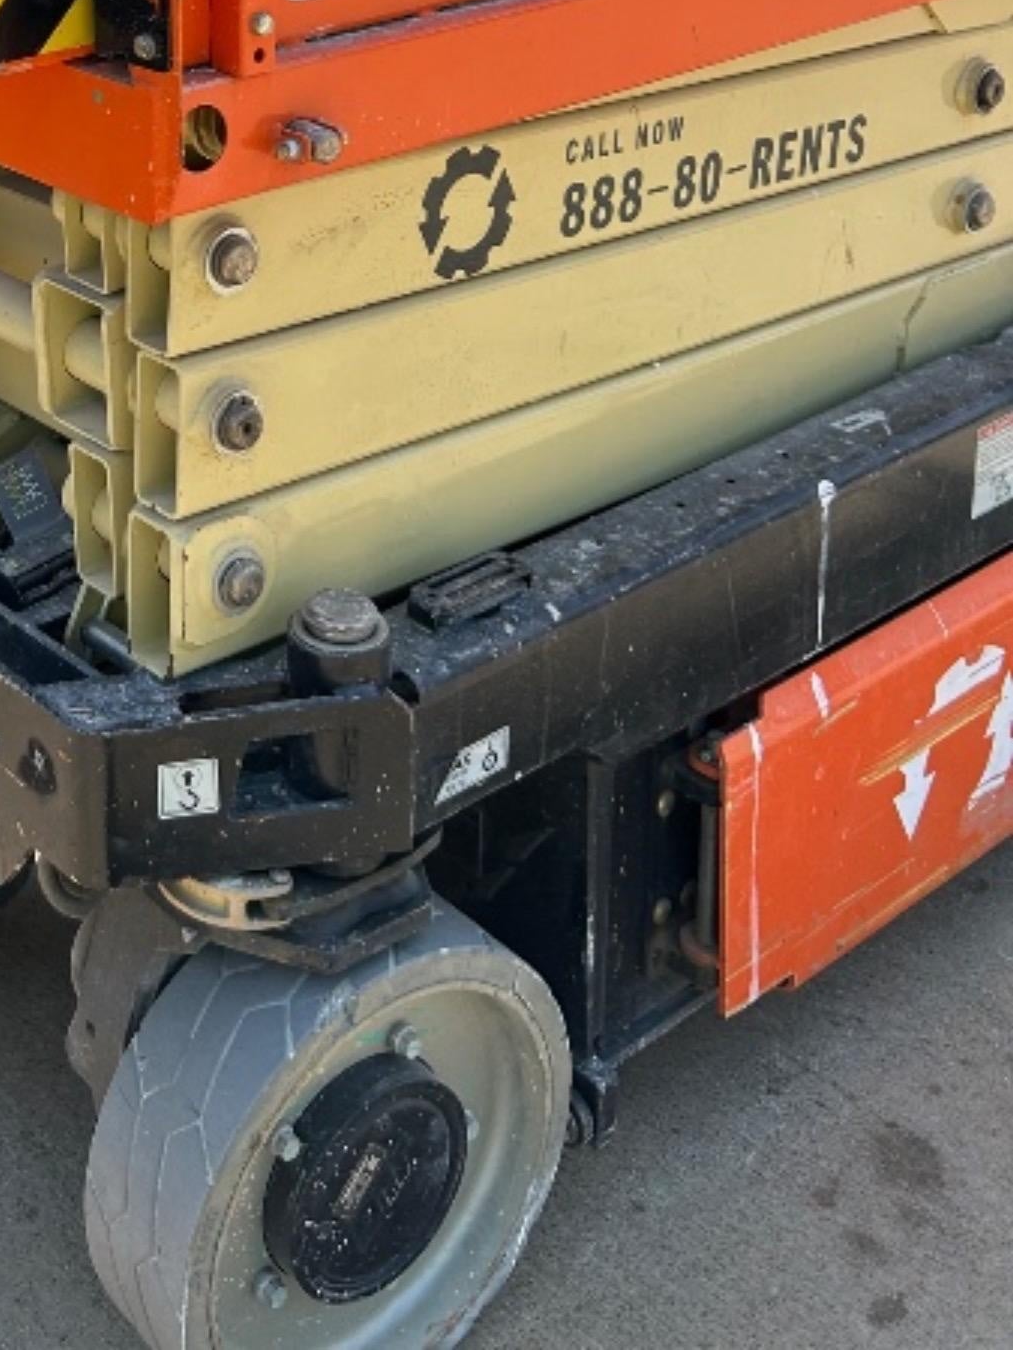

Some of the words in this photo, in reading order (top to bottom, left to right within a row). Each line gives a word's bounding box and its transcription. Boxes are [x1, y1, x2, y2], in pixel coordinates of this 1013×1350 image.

[559, 113, 867, 238] 888-80-RENTS
[565, 129, 624, 165] CALL
[635, 116, 685, 151] NOW
